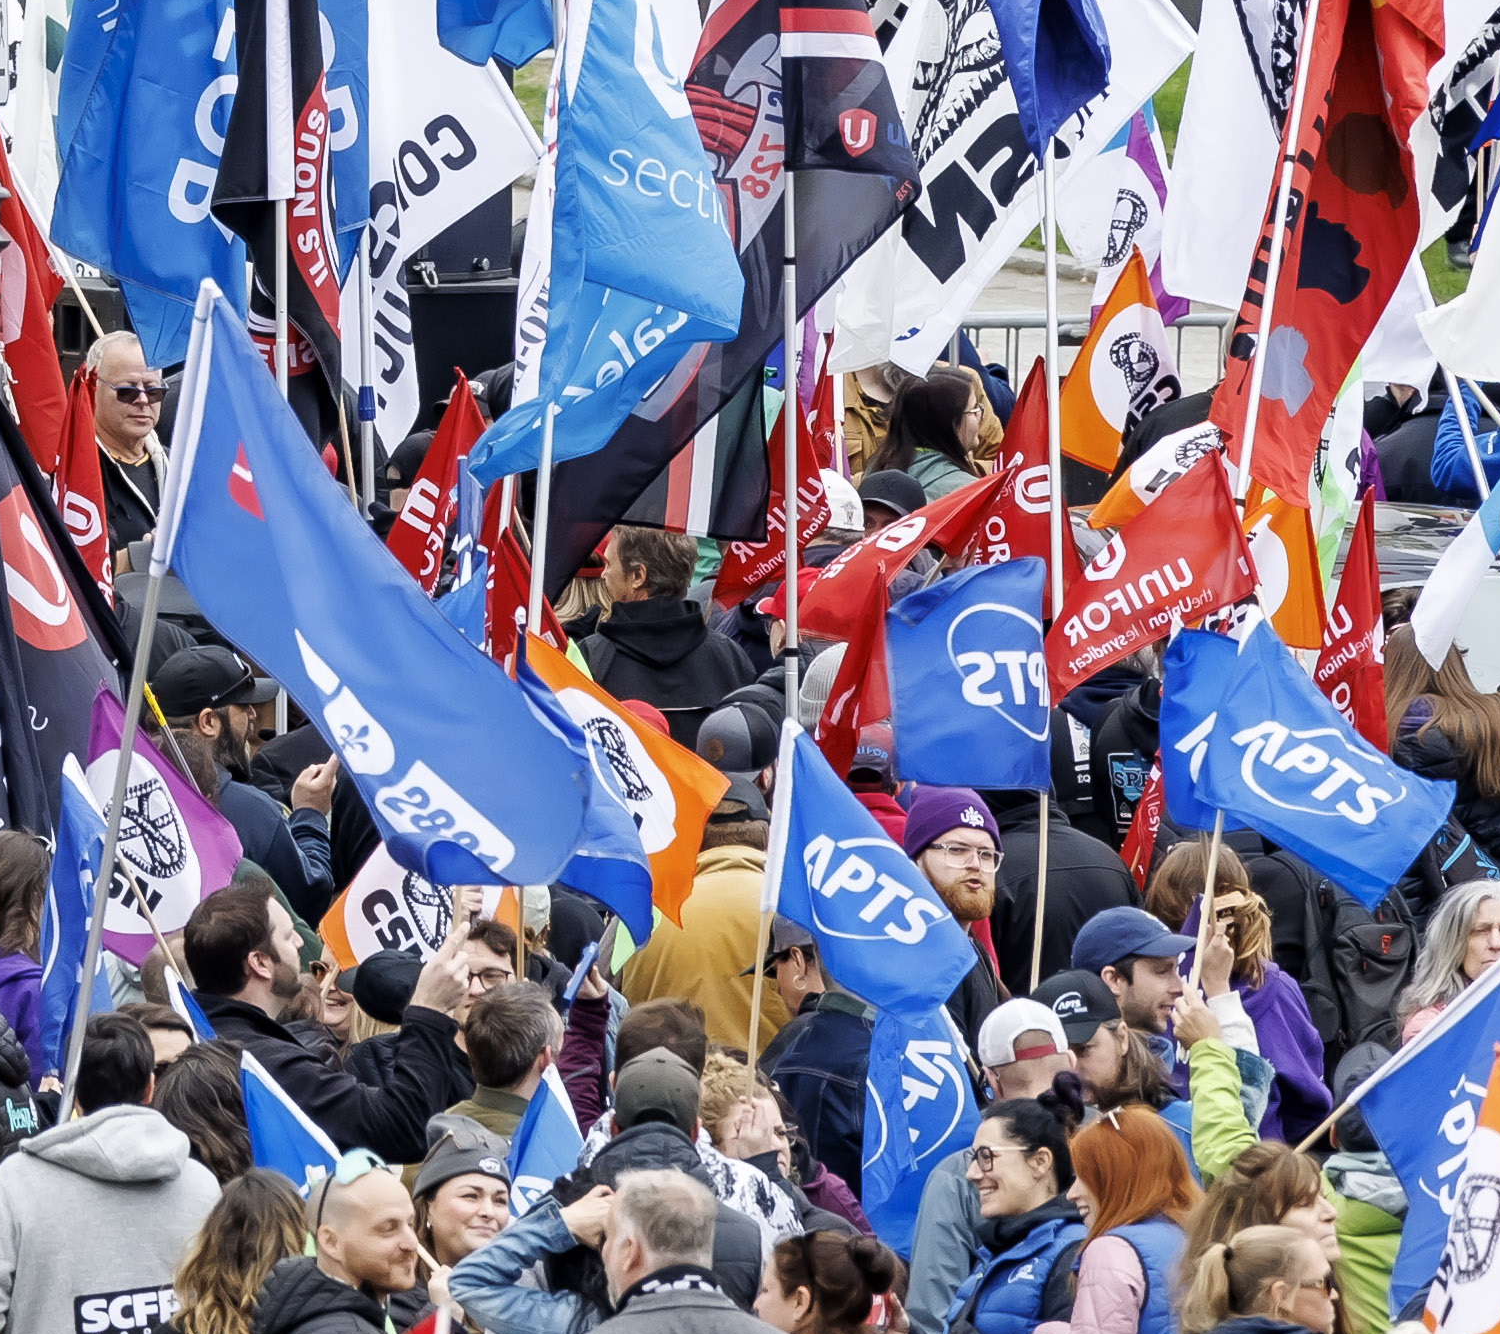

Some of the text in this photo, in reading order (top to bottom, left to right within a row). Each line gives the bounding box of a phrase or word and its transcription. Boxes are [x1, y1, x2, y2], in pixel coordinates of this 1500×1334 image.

[295, 108, 329, 287] ILS NOUS
[1234, 720, 1395, 826] APTS
[803, 836, 948, 945] APTS
